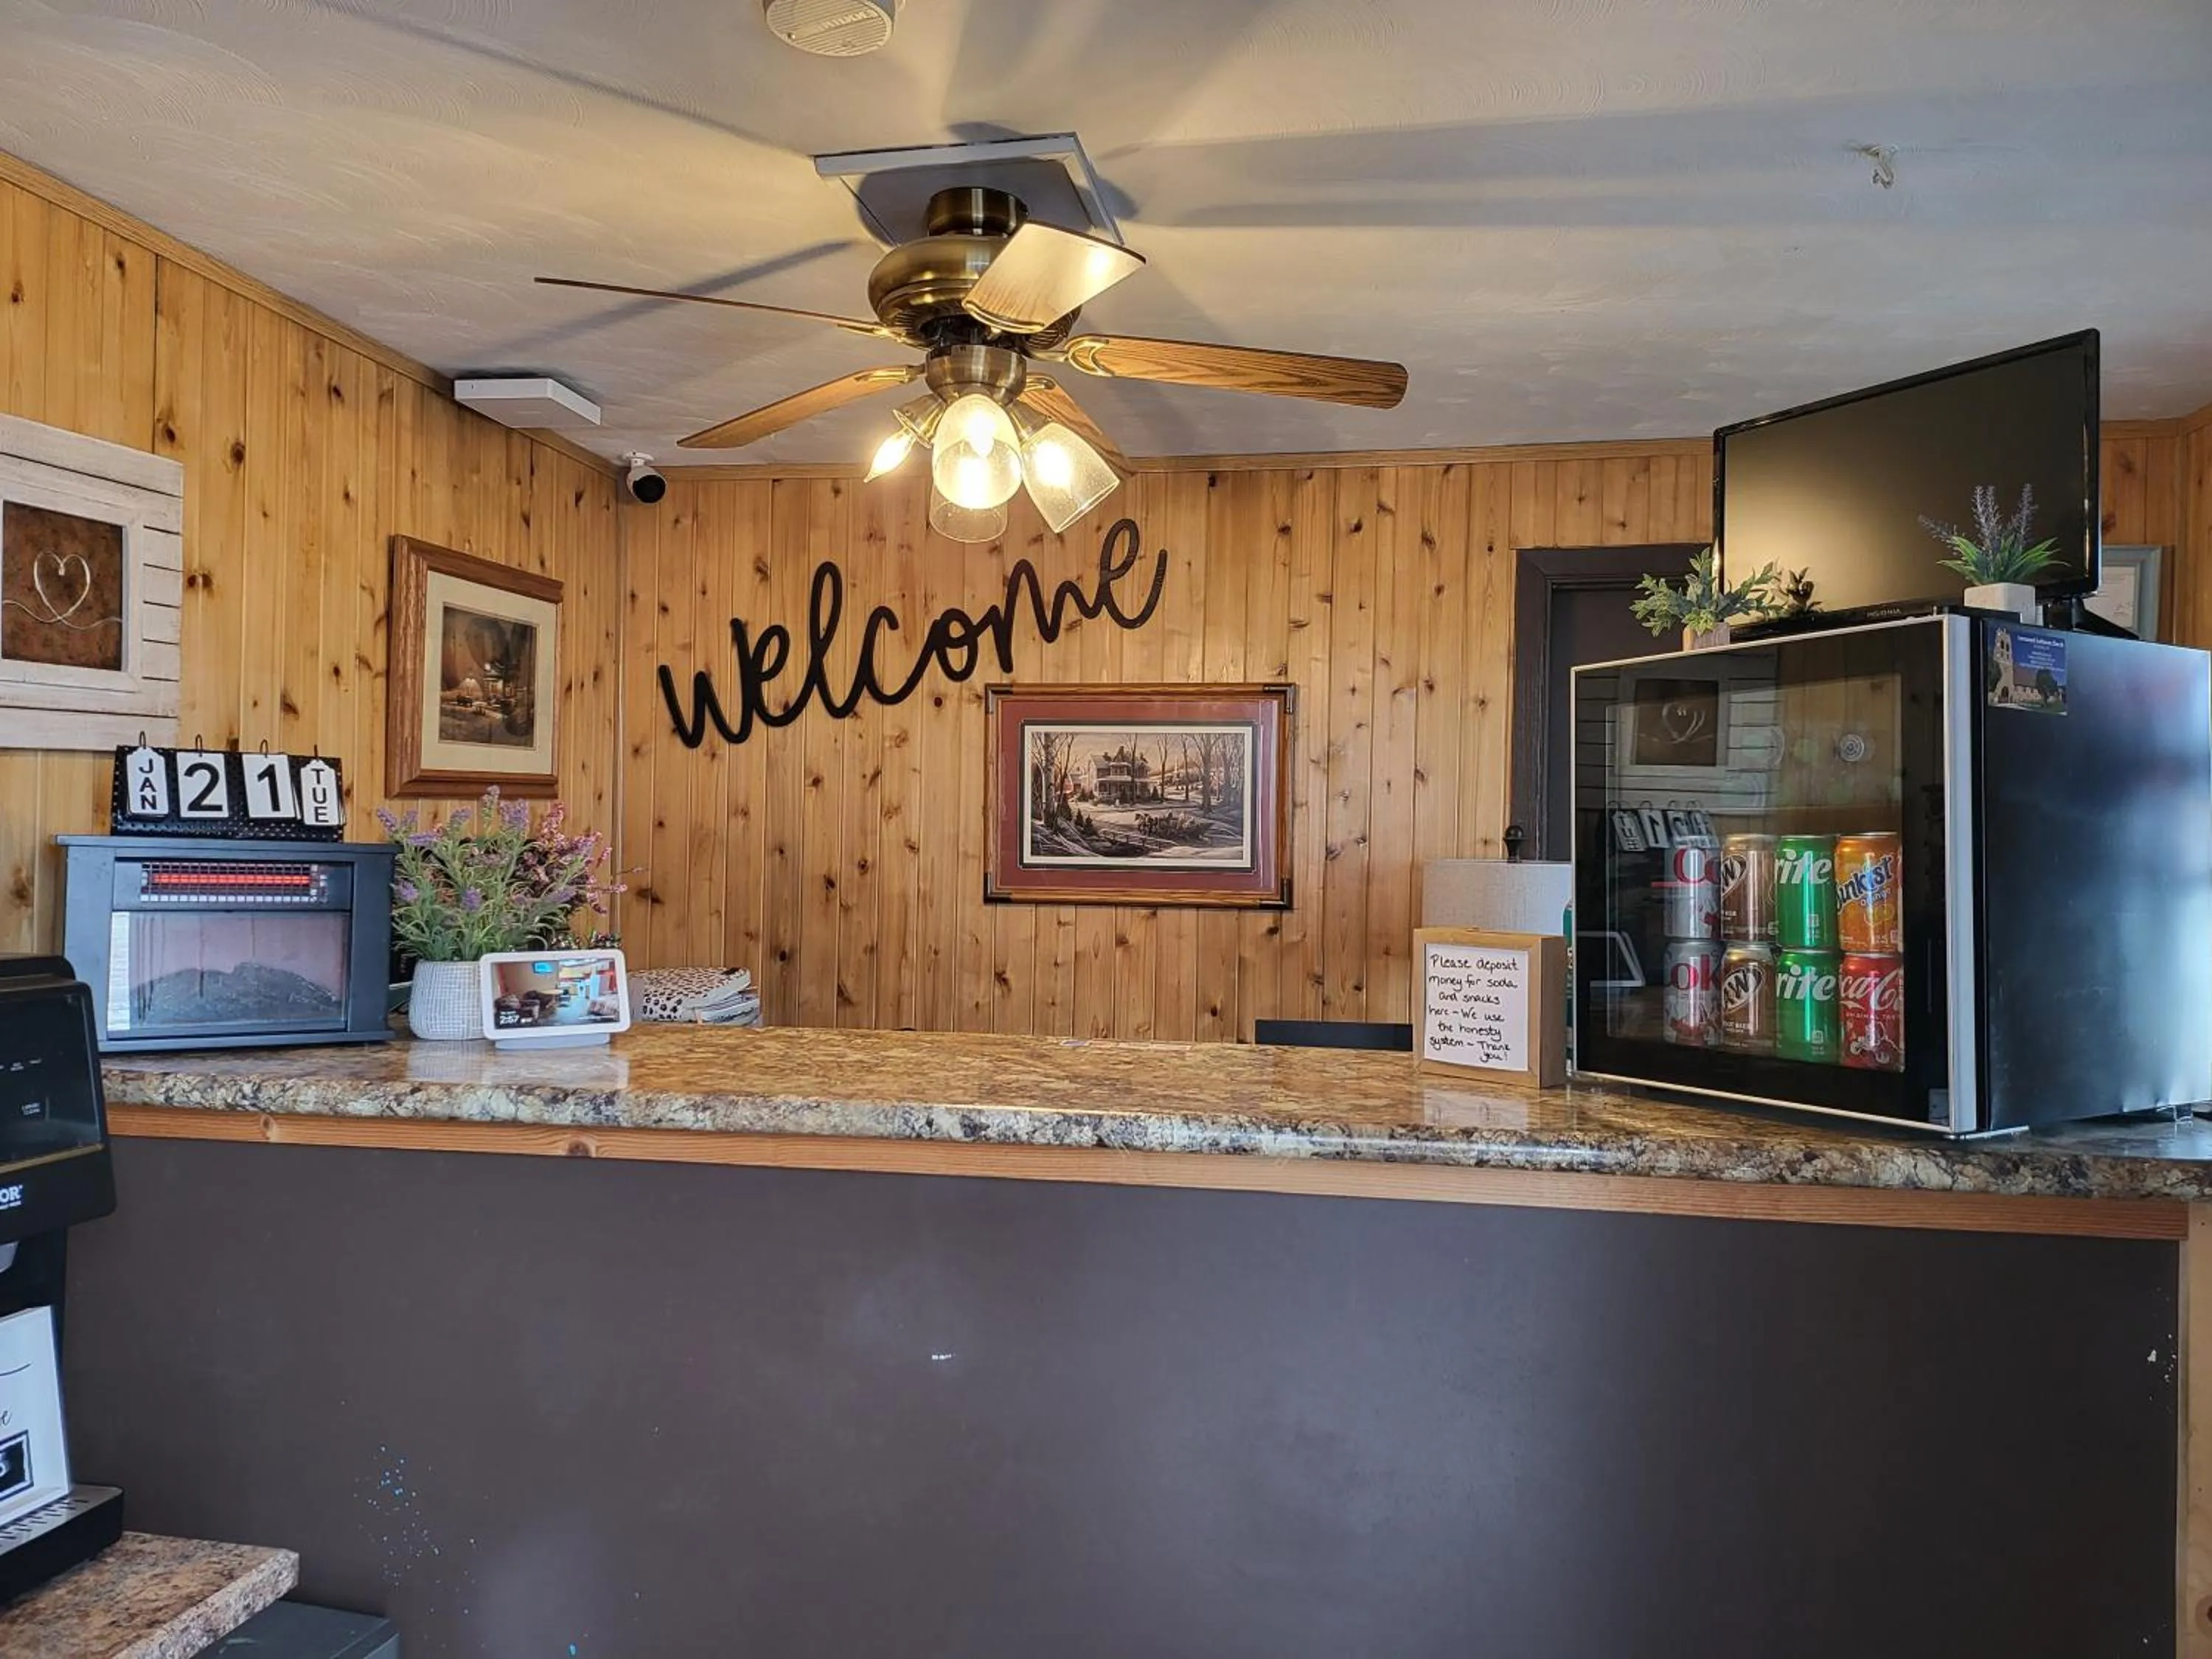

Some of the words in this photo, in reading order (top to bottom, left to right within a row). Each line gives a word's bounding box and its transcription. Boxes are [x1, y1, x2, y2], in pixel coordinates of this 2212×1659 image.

[659, 518, 1168, 748] welcome
[139, 758, 157, 810] JAN
[310, 768, 329, 823] TUE
[1430, 953, 1472, 968] Please
[1476, 957, 1520, 974] deposit
[1429, 975, 1463, 992] money
[1464, 973, 1481, 988] for
[1439, 992, 1458, 1002] and
[1462, 993, 1500, 1005] snacks
[1428, 1004, 1450, 1015] here
[1461, 1006, 1478, 1020] We
[1484, 1014, 1506, 1022] use
[1438, 1020, 1453, 1032] the
[1458, 1023, 1502, 1042] honesty
[1430, 1035, 1464, 1051] system
[1476, 1040, 1511, 1051] Thank
